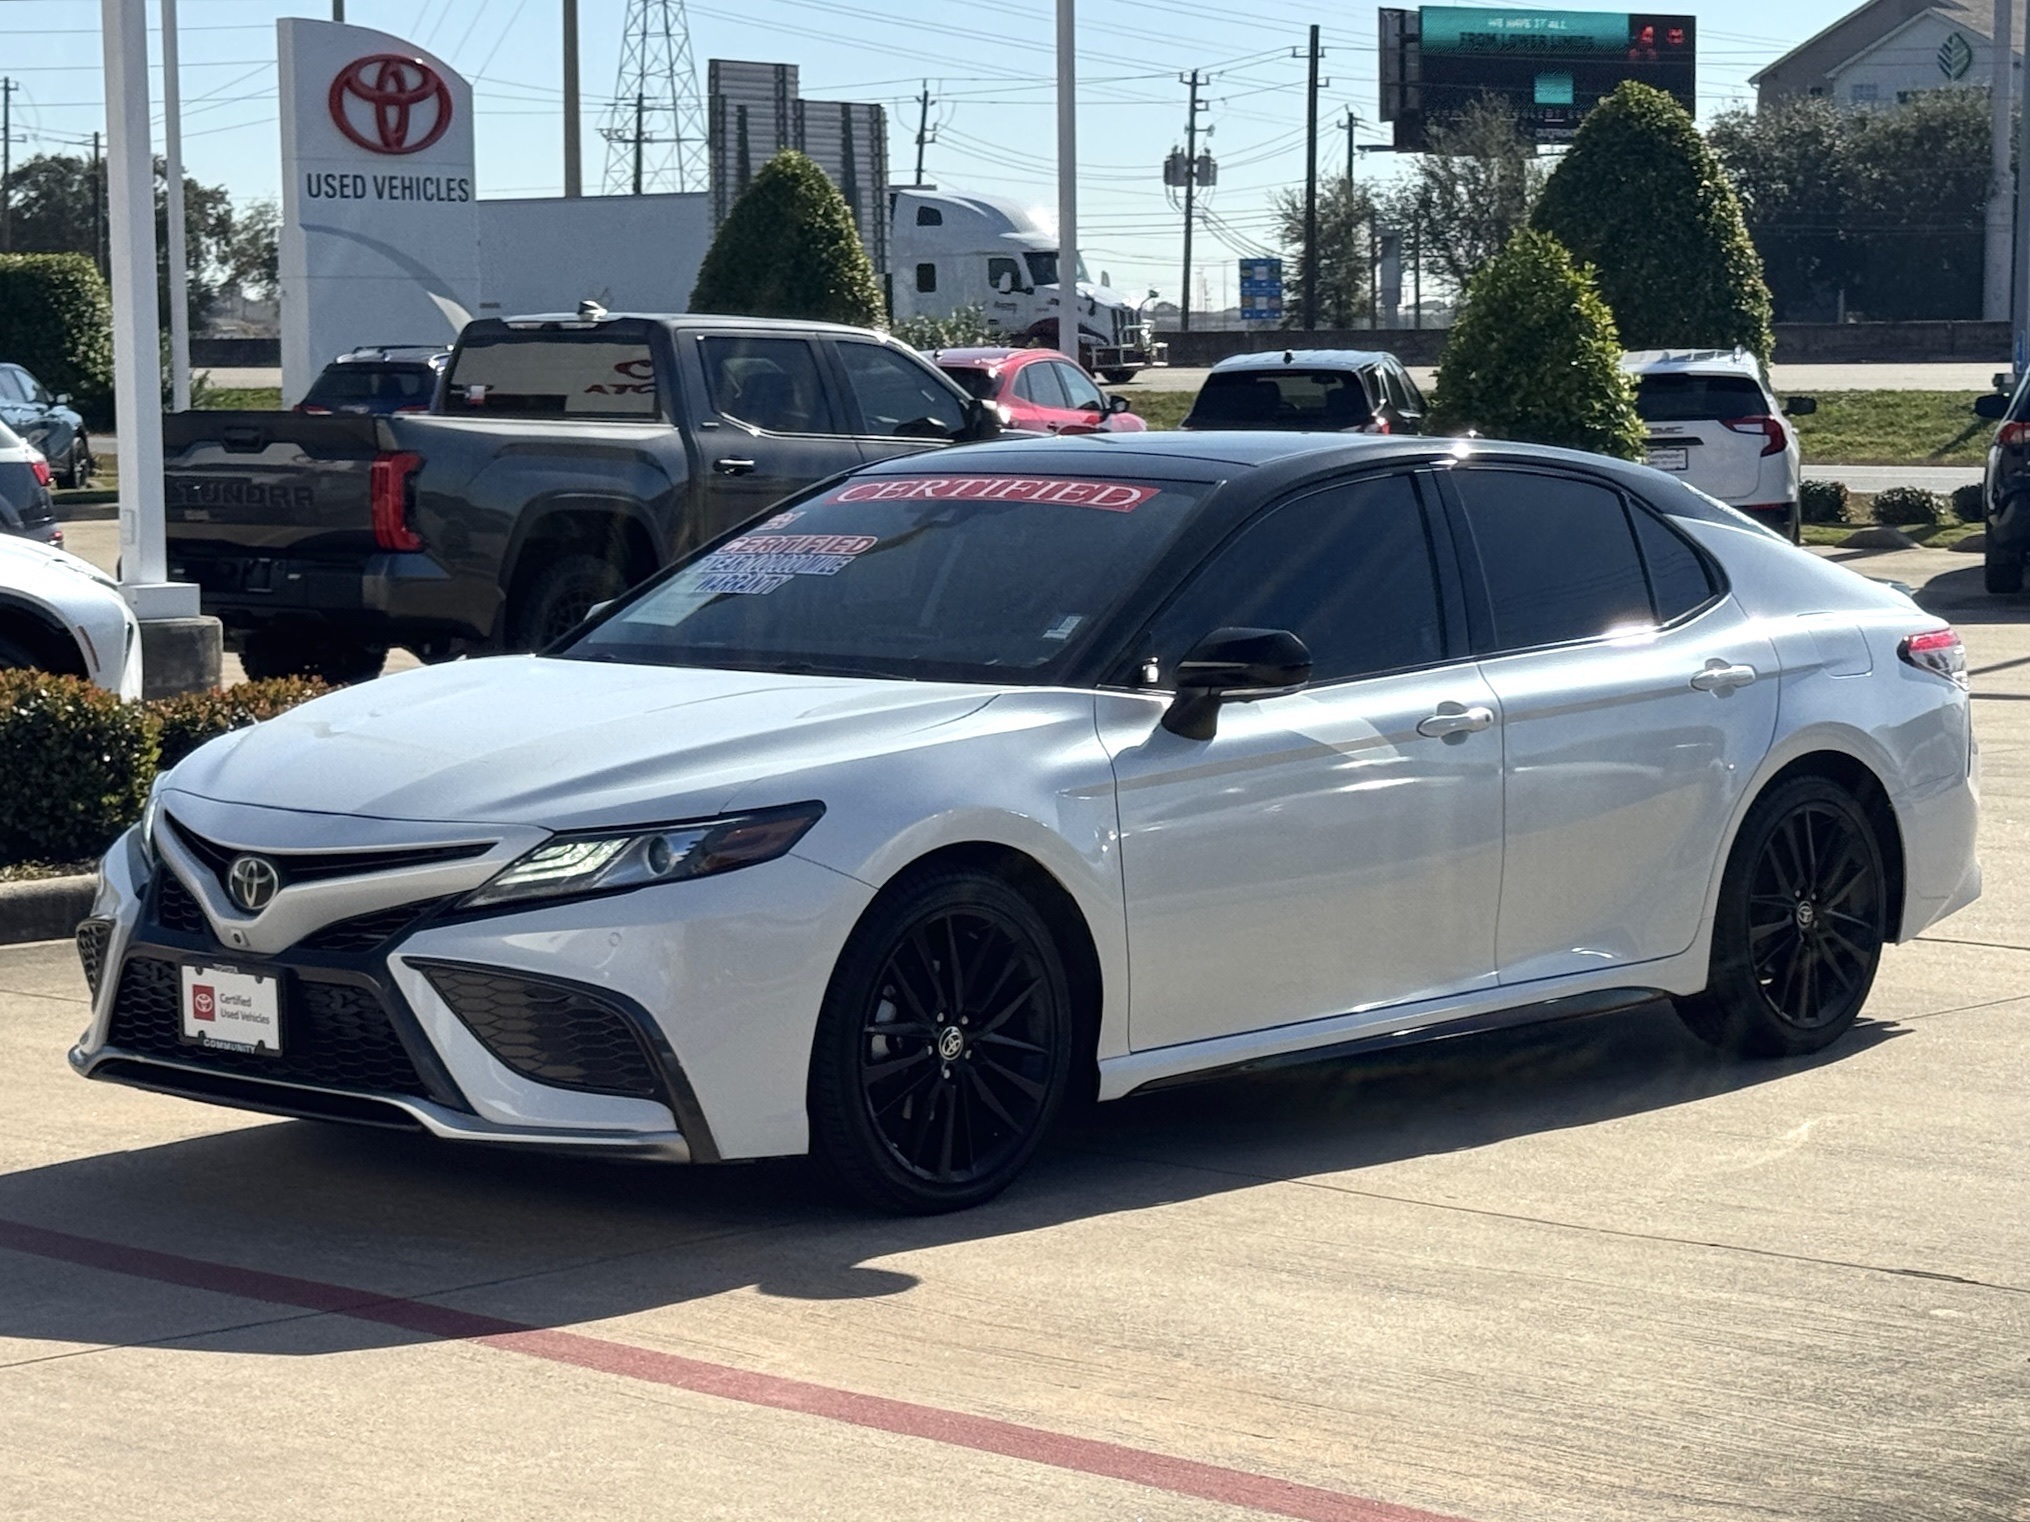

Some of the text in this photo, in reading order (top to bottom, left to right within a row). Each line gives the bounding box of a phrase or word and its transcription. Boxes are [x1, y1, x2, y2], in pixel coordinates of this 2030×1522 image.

[306, 173, 470, 203] USED VEHICLES
[174, 482, 315, 508] TUNDRA
[837, 478, 1142, 508] CERTIFIED
[716, 535, 877, 555] CERTIFIED
[703, 554, 756, 573] YEAR
[796, 555, 856, 576] MILE
[692, 572, 795, 595] WARRANTY
[219, 993, 252, 1008] Certified
[220, 1008, 271, 1025] Used Vehicles
[203, 1039, 256, 1055] COMMUNITY
